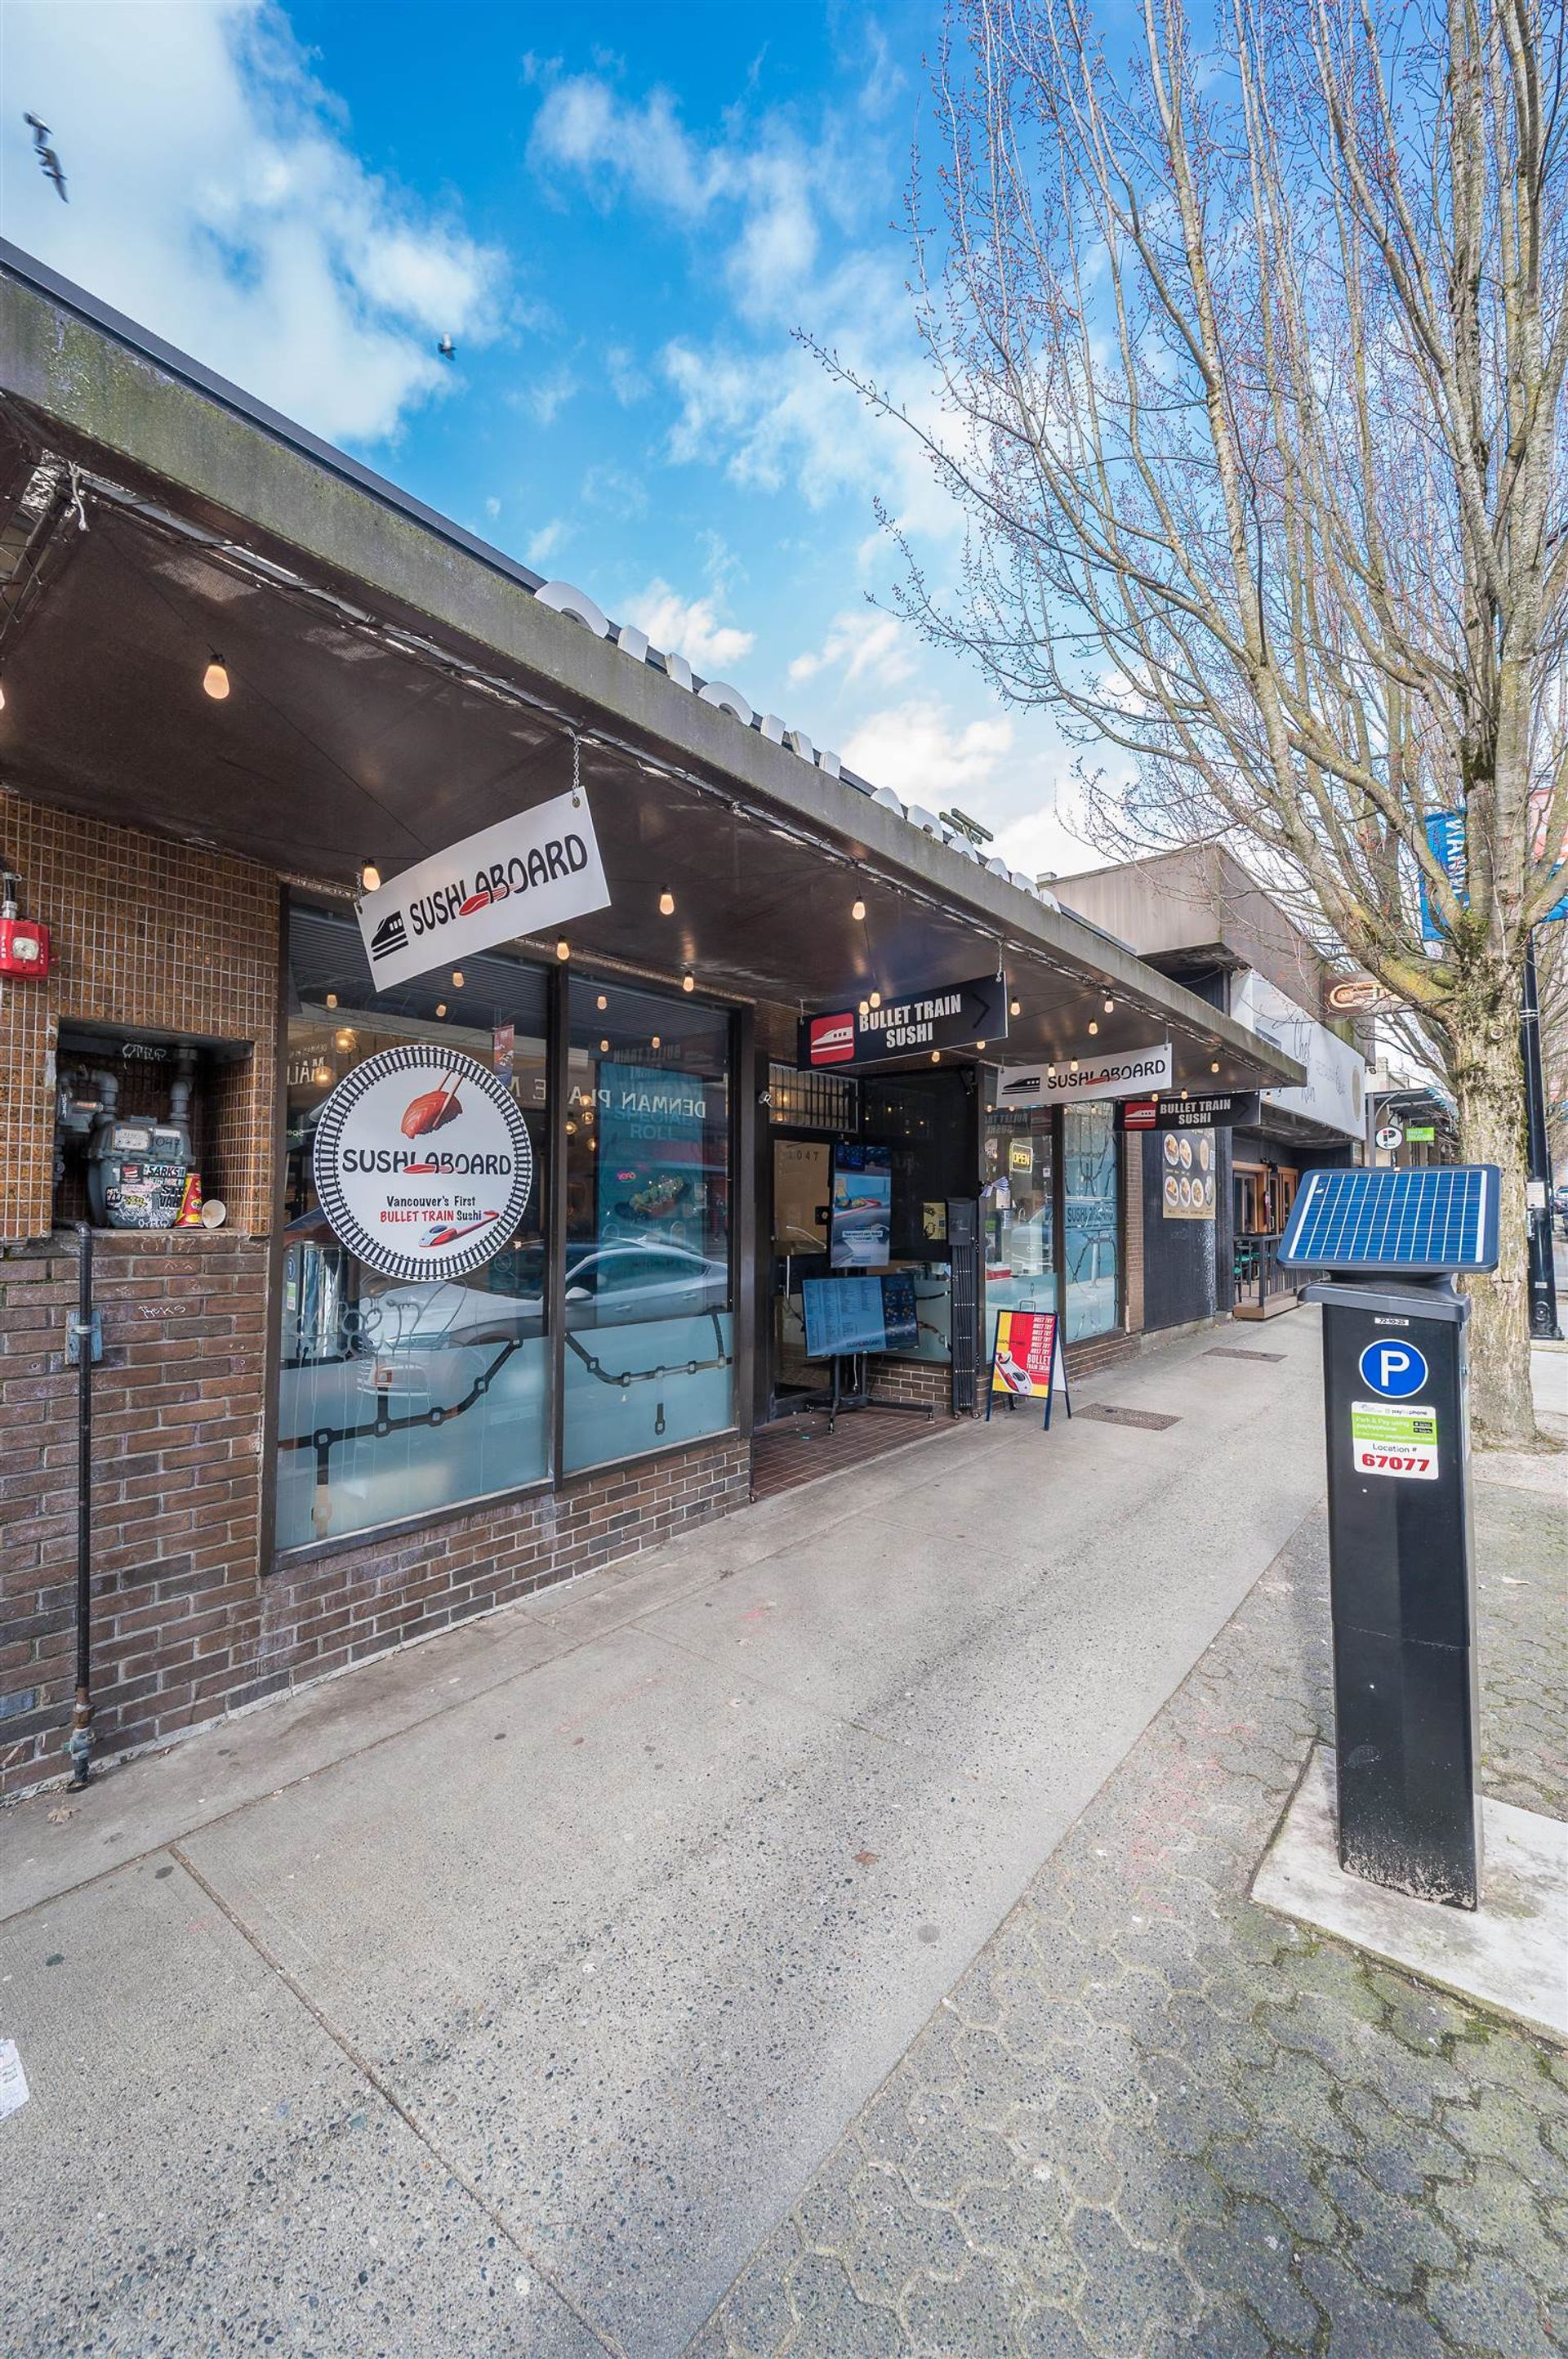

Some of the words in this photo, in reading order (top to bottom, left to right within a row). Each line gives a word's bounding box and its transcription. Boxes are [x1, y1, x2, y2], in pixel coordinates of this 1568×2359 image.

[475, 833, 588, 903] ABOARD
[859, 1006, 911, 1032] BULLET
[914, 993, 961, 1021] TRAIN
[885, 1022, 933, 1049] SUSHI
[1100, 1059, 1166, 1080] ABOARD
[1160, 1101, 1196, 1115] BULLET
[1199, 1099, 1232, 1112] TRAIN
[1178, 1113, 1212, 1125] SUSHI
[425, 1151, 512, 1175] ABOARD
[1013, 1151, 1030, 1166] OPEN
[386, 1196, 449, 1207] Vancouver's
[454, 1196, 476, 1207] First
[380, 1210, 421, 1223] BULLET
[421, 1210, 454, 1222] TRAIN
[457, 1210, 482, 1220] Sushi
[1027, 1353, 1052, 1366] BULLET
[1380, 1349, 1410, 1387] P
[1372, 1443, 1410, 1453] Location
[1362, 1454, 1430, 1472] 67077
